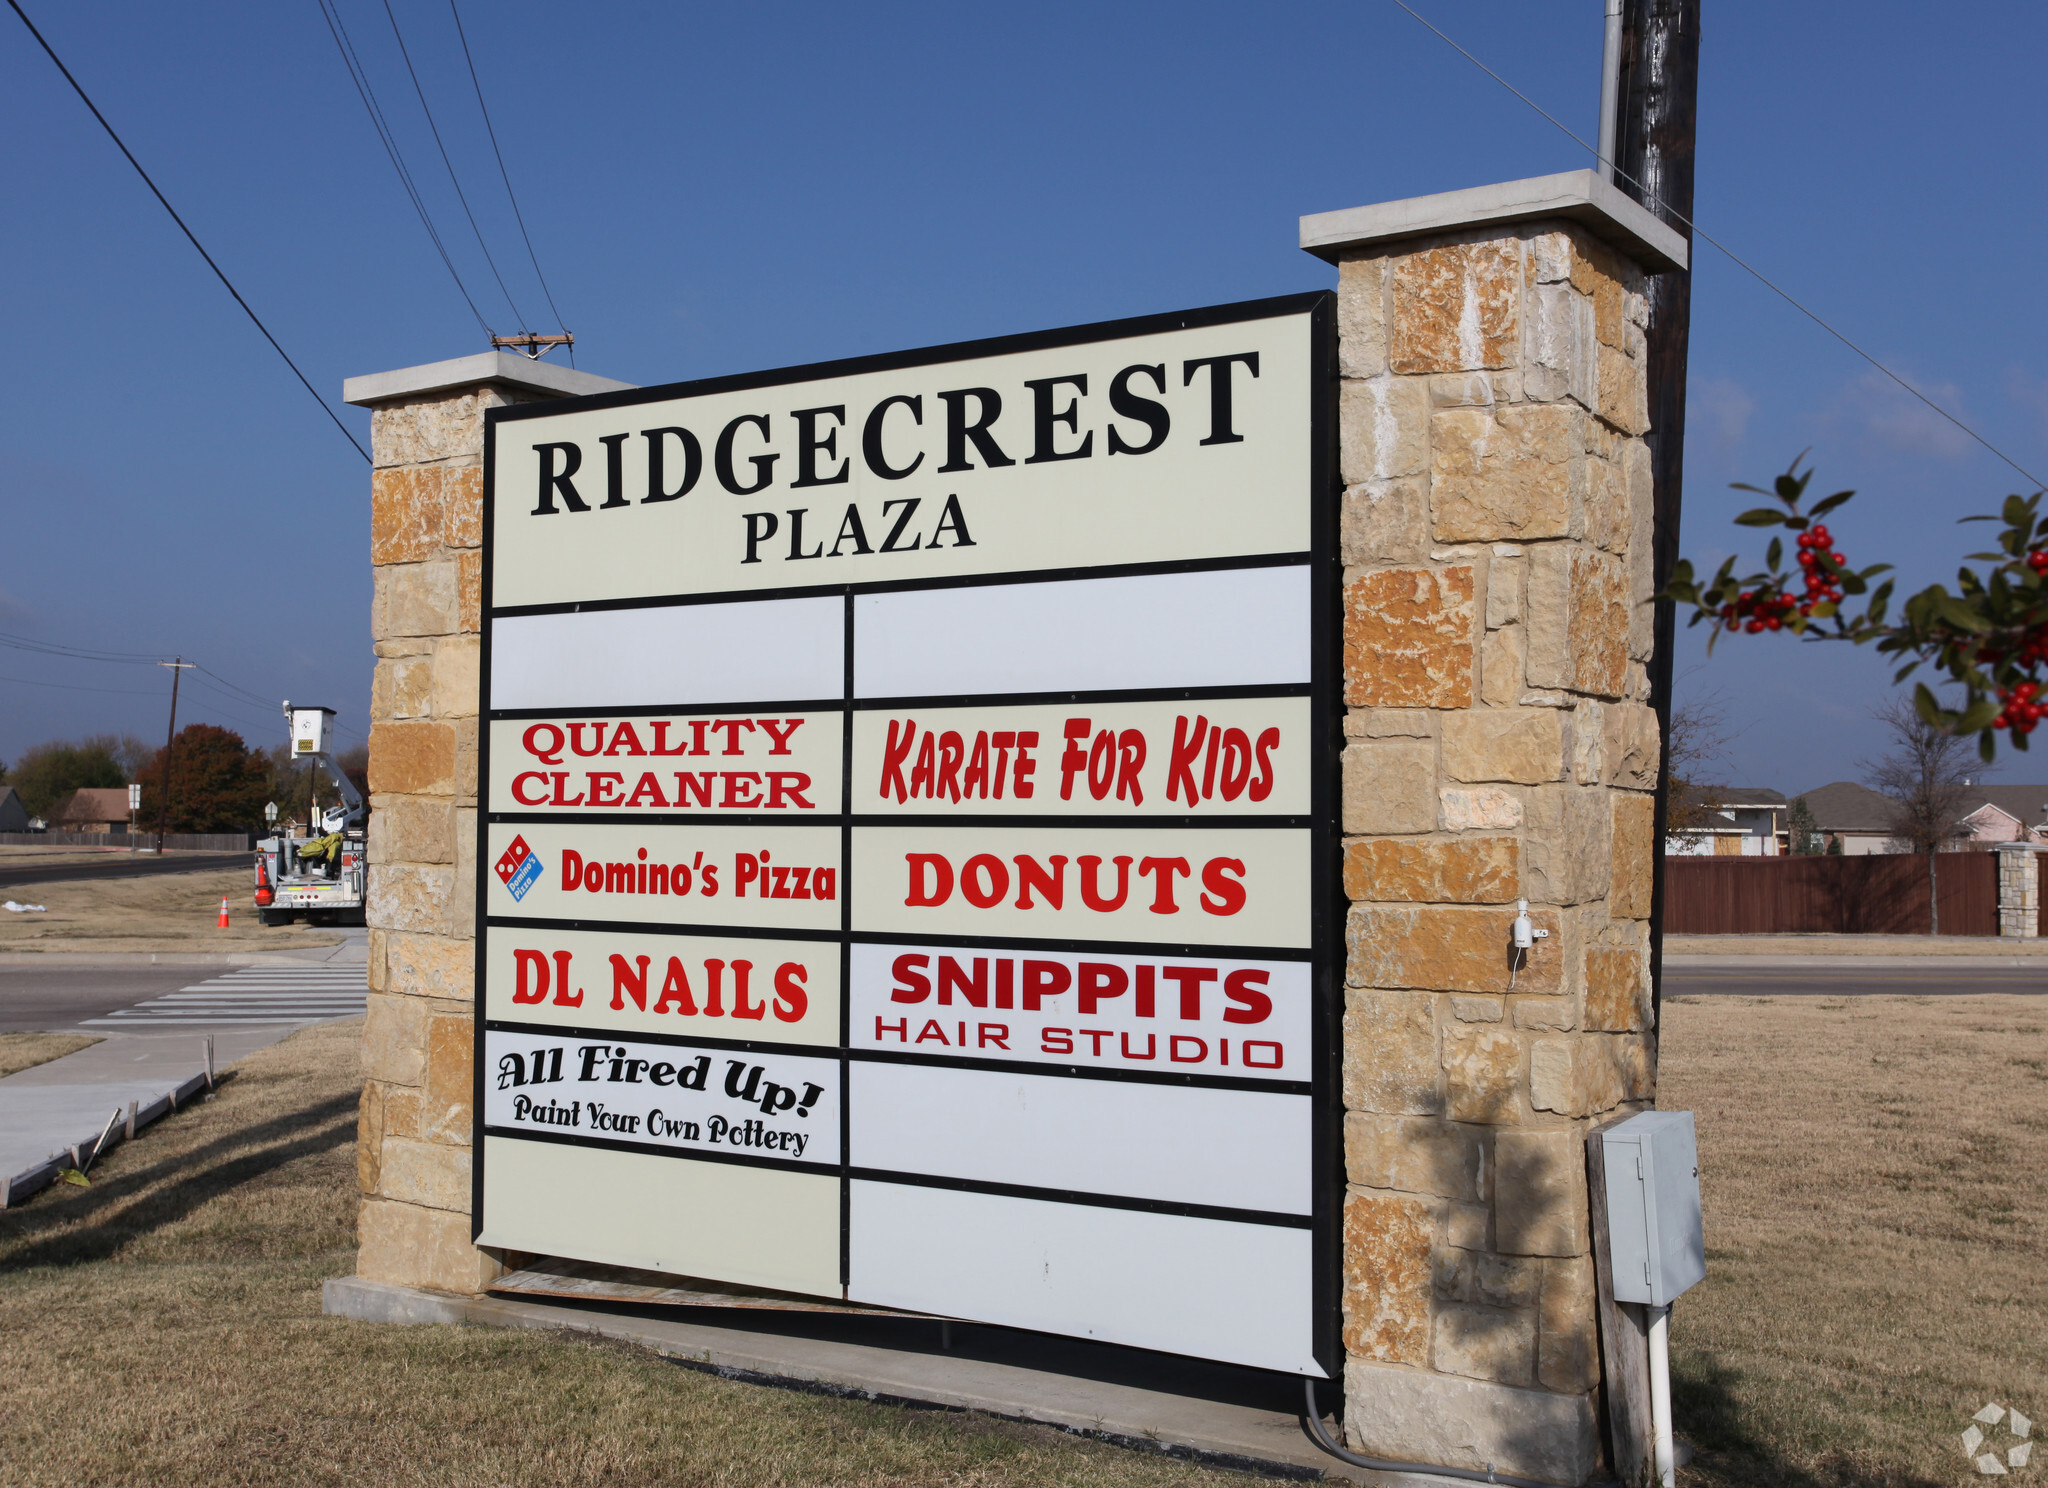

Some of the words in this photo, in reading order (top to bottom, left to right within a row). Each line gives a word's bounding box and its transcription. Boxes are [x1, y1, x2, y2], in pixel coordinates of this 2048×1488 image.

[531, 351, 1260, 515] RIDGECREST
[741, 493, 976, 563] PLAZA
[522, 718, 805, 765] QUALITY
[879, 718, 1040, 805] KARATE
[1060, 717, 1147, 807] FOR
[1166, 714, 1281, 809] KIDS
[511, 771, 816, 809] CLEANER
[508, 857, 536, 892] Domino's
[514, 877, 533, 900] Pizza
[561, 847, 720, 898] Domino's
[735, 849, 836, 901] Pizza
[904, 852, 1247, 917] DONUTS
[512, 948, 584, 1009] DL
[608, 953, 809, 1023] NAILS
[890, 953, 1273, 1025] SNIPPITS
[875, 1015, 1012, 1051] HAIR
[1040, 1026, 1284, 1070] STUDIO
[497, 1047, 564, 1091] All
[577, 1045, 712, 1092] Fired
[724, 1059, 825, 1118] Up!
[513, 1093, 581, 1127] Paint
[586, 1102, 641, 1134] Your
[646, 1108, 701, 1141] Own
[707, 1114, 809, 1158] Pottery
